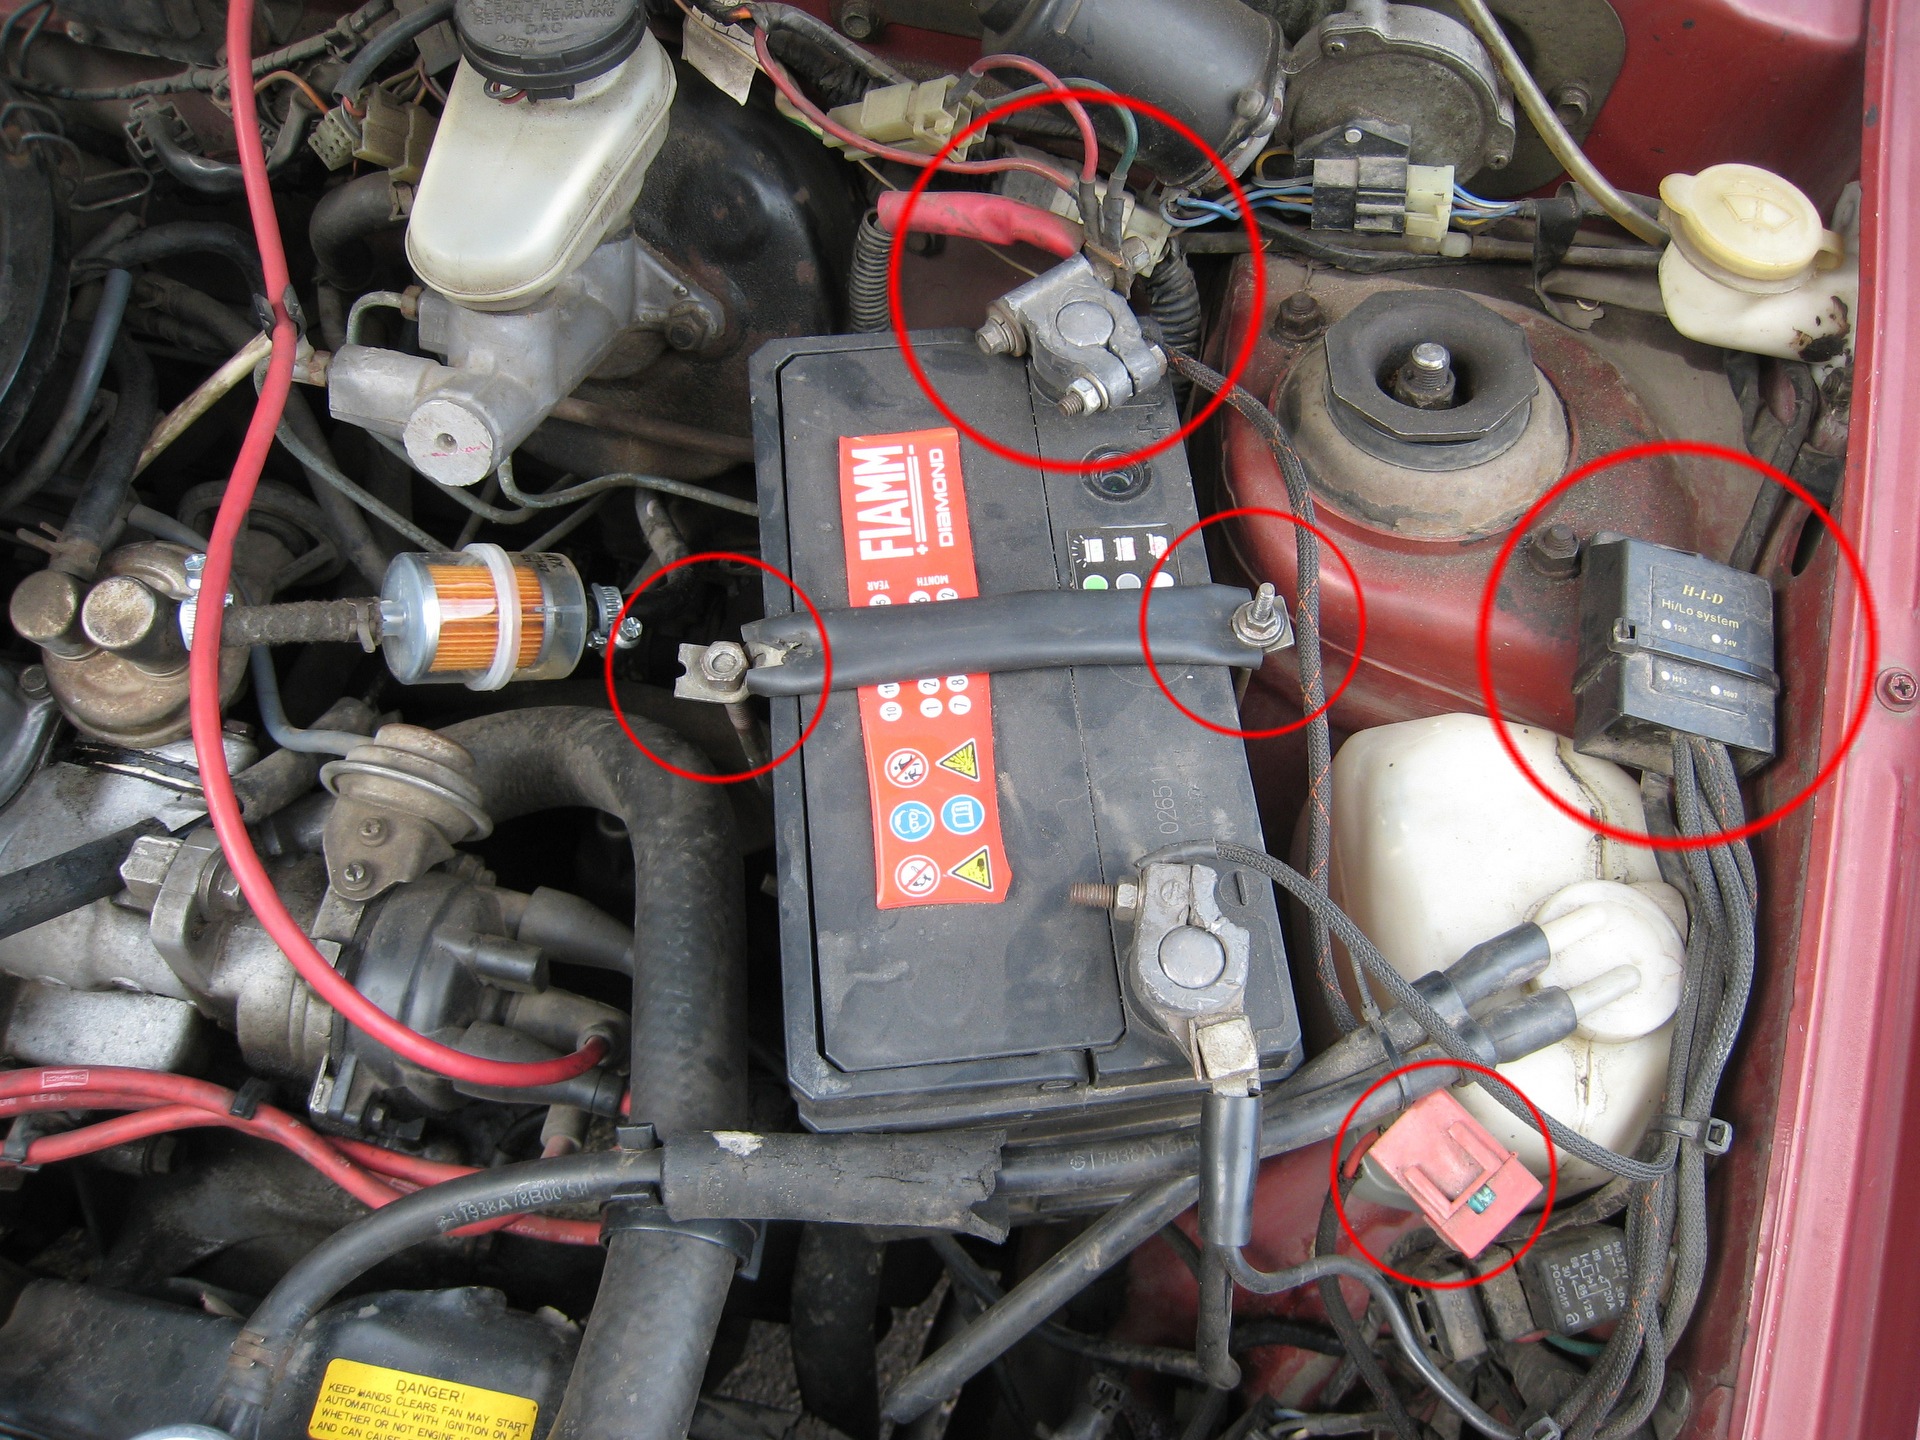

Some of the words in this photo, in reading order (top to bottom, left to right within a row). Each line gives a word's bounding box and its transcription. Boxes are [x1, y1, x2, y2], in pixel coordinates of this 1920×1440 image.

[475, 12, 533, 25] BEFORE
[543, 7, 616, 21] REMOVING
[495, 33, 536, 49] OPEN
[851, 445, 914, 561] FIAMM
[929, 448, 955, 547] DIAMOND
[867, 580, 890, 591] YEAR
[916, 574, 949, 587] MONTH
[1682, 584, 1724, 605] H-I-D
[1661, 598, 1694, 616] Hi/Lo
[1696, 610, 1740, 630] system
[1673, 623, 1688, 633] 12V
[1723, 638, 1737, 648] 24V
[1672, 674, 1687, 685] H13
[886, 706, 897, 717] 10
[1561, 1265, 1571, 1278] 30
[1550, 1263, 1570, 1308] РОССИЯ
[396, 1379, 467, 1404] DANGER!
[328, 1382, 361, 1396] KEEP
[358, 1388, 392, 1404] HANDS
[441, 1407, 463, 1419] FAN
[467, 1411, 490, 1425] MAY
[495, 1417, 529, 1433] START
[321, 1407, 371, 1427] WHETHER
[374, 1418, 390, 1430] OR
[392, 1422, 414, 1436] NOT
[417, 1429, 456, 1440] ENGINE
[324, 1395, 409, 1420] AUTOMATICALLY
[412, 1413, 439, 1426] WITH
[444, 1419, 490, 1437] IGNITION
[492, 1429, 508, 1440] ON
[316, 1420, 338, 1432] AND
[341, 1425, 363, 1437] CAN
